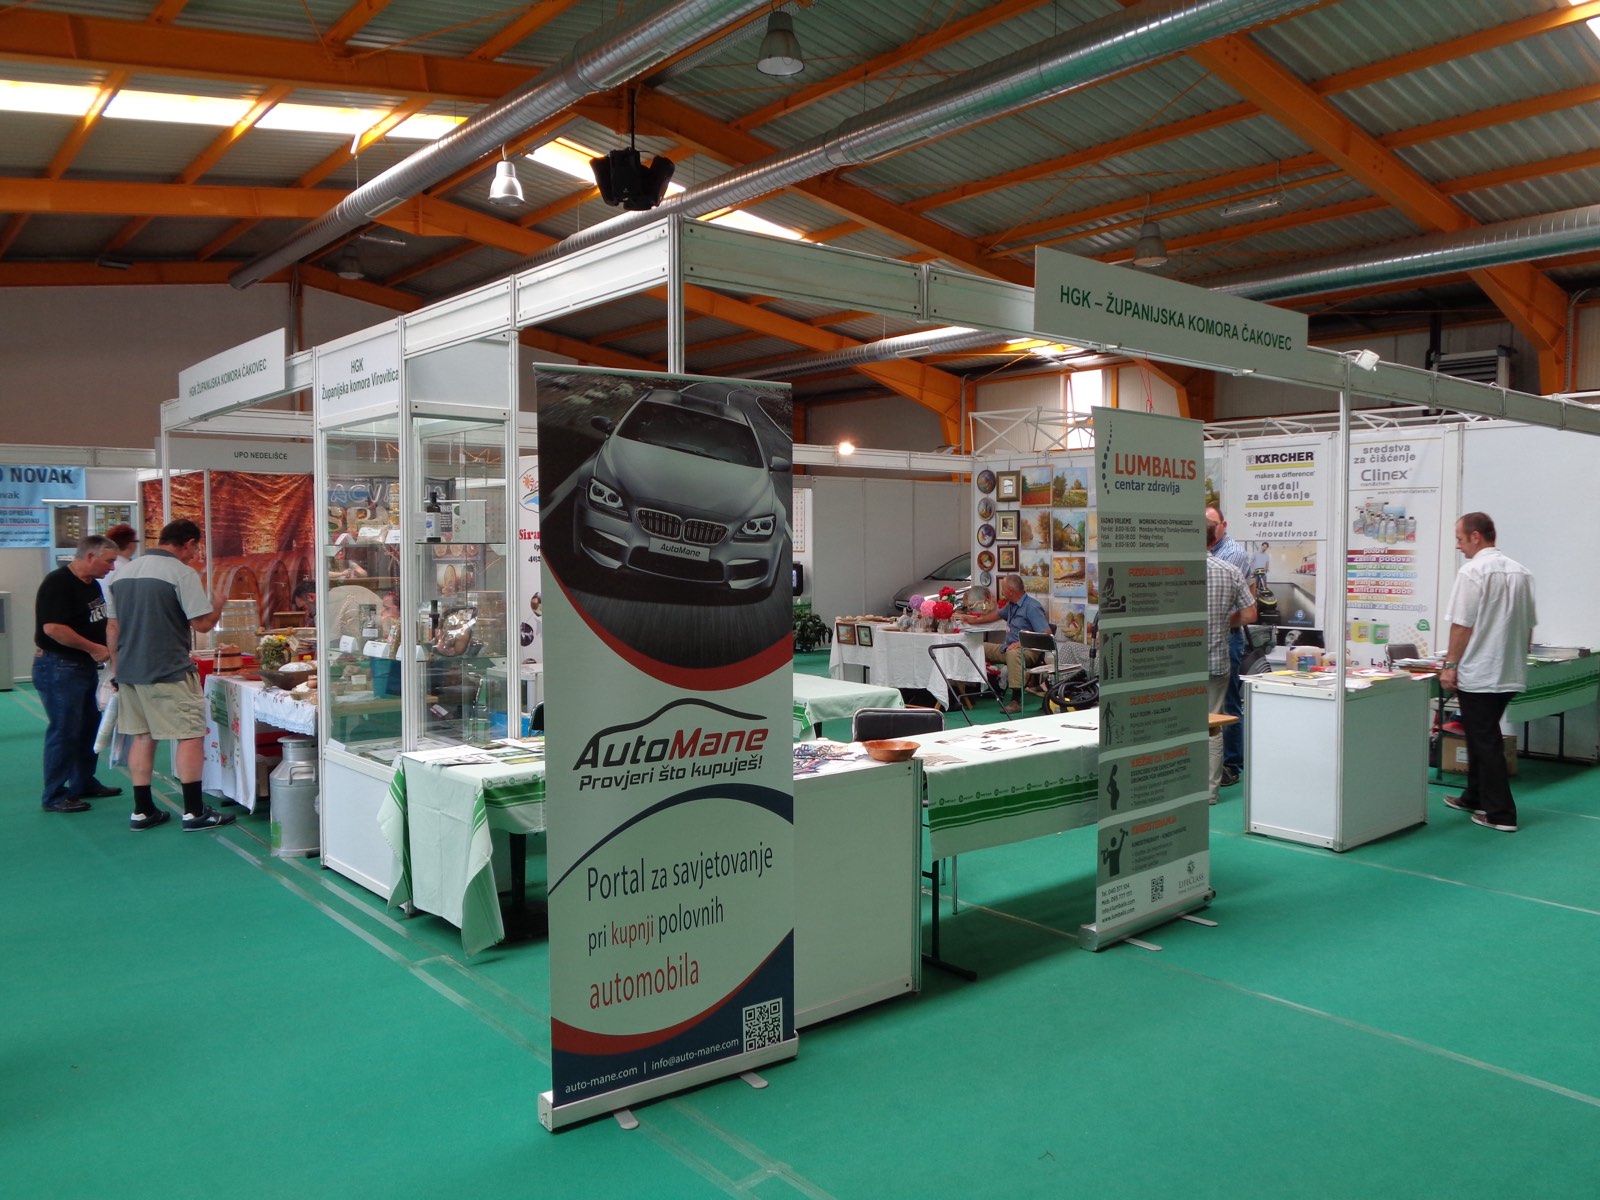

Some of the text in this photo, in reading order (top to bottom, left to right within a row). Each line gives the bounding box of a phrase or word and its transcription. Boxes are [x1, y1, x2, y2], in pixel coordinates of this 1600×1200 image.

[1060, 284, 1091, 309] HGK
[1106, 292, 1186, 330] ŽUPANIJSKA
[1188, 315, 1239, 341] KOMORA
[1241, 323, 1292, 351] ČAKOVEC
[220, 368, 241, 385] KOMORA
[241, 358, 267, 378] ČAKOVEC
[350, 357, 364, 374] HGK
[321, 367, 399, 402] Županijska komora Virovitica
[233, 451, 249, 459] UPO
[1255, 451, 1314, 464] KÄRCHER
[1362, 444, 1411, 454] sredstva
[1114, 452, 1197, 481] LUMBALIS
[1369, 453, 1416, 463] čišćenje
[10, 467, 74, 484] NOVAK
[1360, 469, 1408, 482] Clinex
[1114, 479, 1180, 496] centar zdravlja
[1260, 481, 1299, 491] uređaji
[1263, 491, 1310, 501] čišćenje
[660, 543, 701, 557] AutoMane
[573, 727, 769, 771] AutoMane
[578, 755, 763, 792] Provjeri što kupuješ!
[587, 841, 773, 901] Portal za savjetovanje
[587, 896, 724, 957] pri kupnji polovnih
[589, 954, 699, 1010] automobila
[565, 1065, 638, 1094] auto-mane.com
[651, 1036, 739, 1071] info@auto-mane.com
